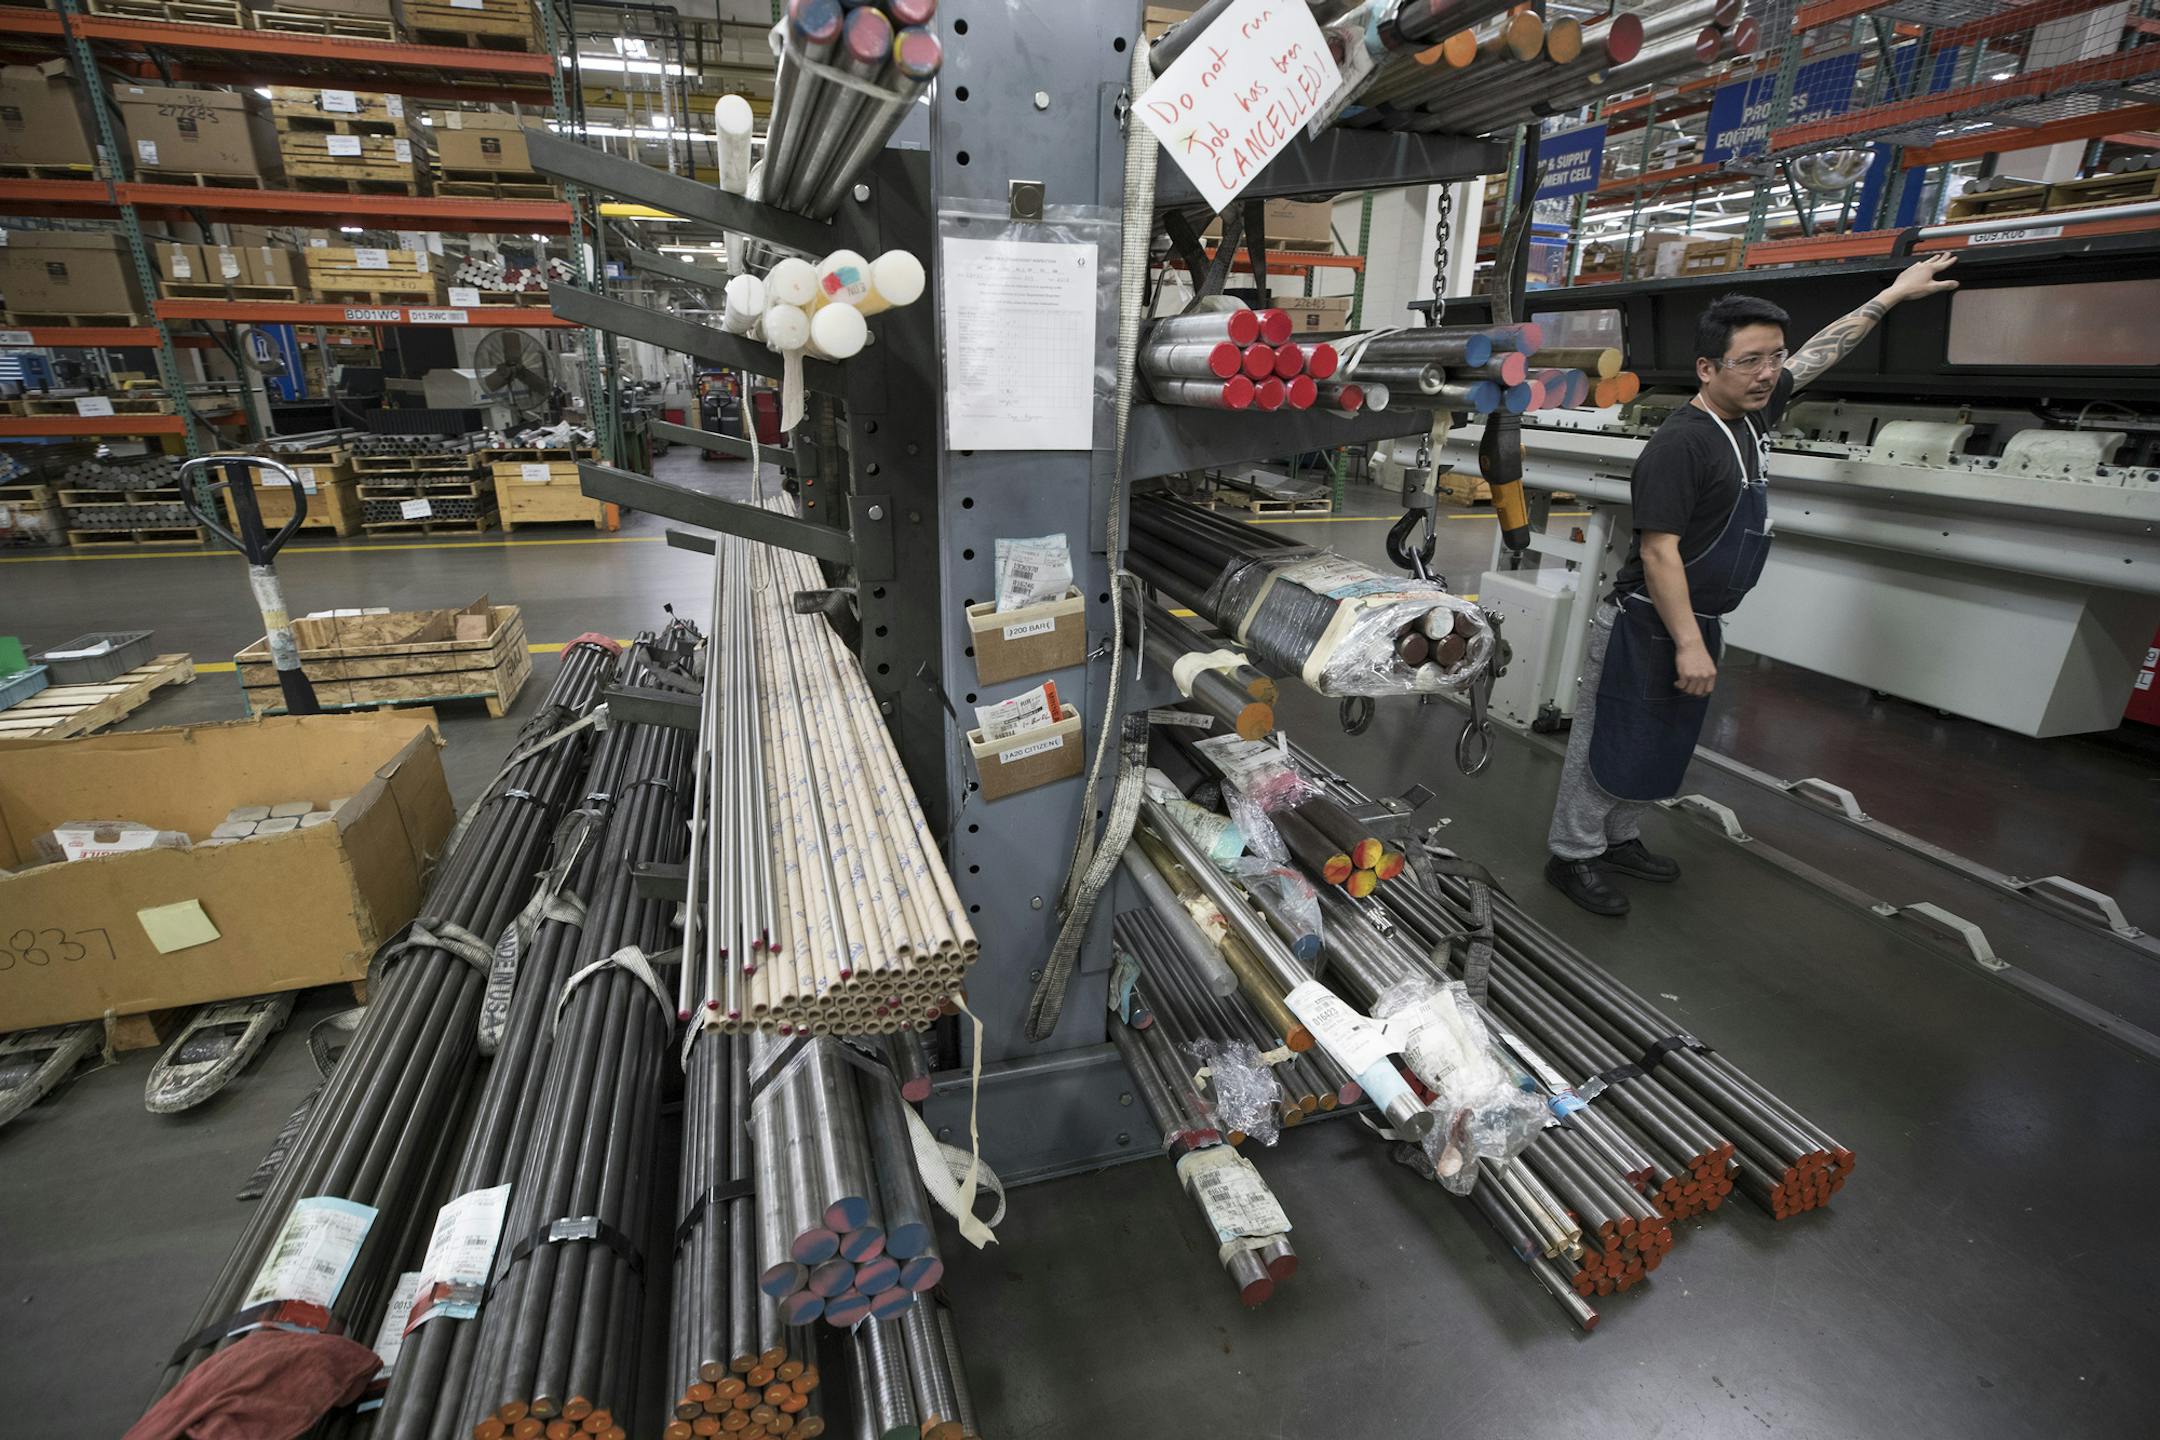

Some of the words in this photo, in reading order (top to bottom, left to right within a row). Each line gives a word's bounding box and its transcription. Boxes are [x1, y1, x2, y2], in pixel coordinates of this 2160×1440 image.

[1147, 93, 1194, 125] Do
[1201, 46, 1230, 88] not
[1241, 10, 1272, 39] run
[1179, 121, 1230, 160] Job
[1234, 80, 1268, 112] has
[1271, 43, 1302, 74] been
[1216, 51, 1330, 190] CANCELLED!
[1556, 149, 1592, 169] SUPPLY
[1570, 167, 1593, 183] CELL
[495, 925, 517, 967] MADE
[491, 971, 514, 985] IN
